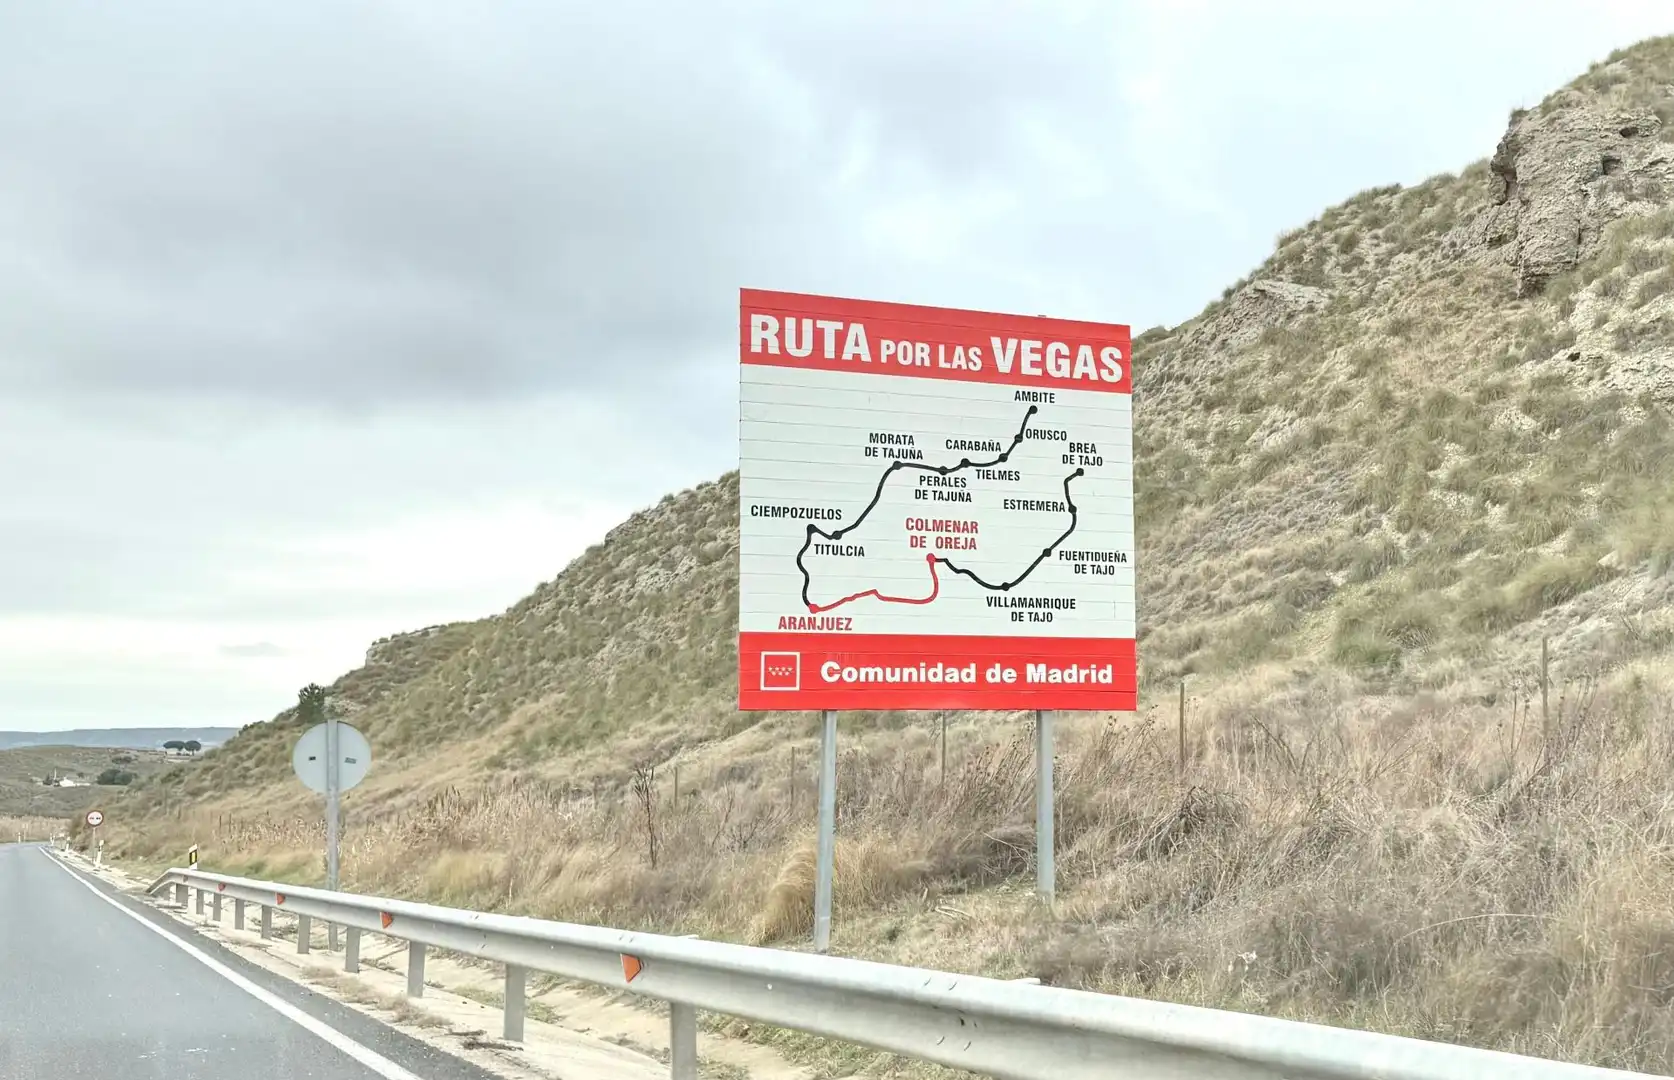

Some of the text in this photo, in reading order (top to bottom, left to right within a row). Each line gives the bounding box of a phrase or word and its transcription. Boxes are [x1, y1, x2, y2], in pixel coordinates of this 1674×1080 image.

[750, 314, 1123, 383] RUTA POR LAS VEGAS
[1014, 390, 1055, 404] AMBITE
[869, 433, 915, 446] MORATA
[1026, 429, 1067, 441] ORUSCO
[946, 438, 1002, 452] CARABAÑA
[1069, 442, 1097, 454] BREA
[865, 446, 923, 460] DE TAJUÑA
[1062, 454, 1103, 467] DE TAJO
[919, 475, 967, 488] PERALES
[976, 469, 1020, 482] TIELMES
[915, 489, 972, 503] DE TAJUÑA
[750, 505, 842, 521] CIEMPOZUELOS
[1003, 499, 1066, 513] ESTREMERA
[906, 517, 979, 534] COLMENAR
[910, 535, 977, 550] DE OREJA
[814, 544, 865, 557] TITULCIA
[1059, 550, 1127, 563] FUENTIDUEÑA
[1074, 563, 1115, 576] DE TAJO
[986, 596, 1076, 610] VILLAMANRIQUE
[778, 616, 853, 631] ARANJUEZ
[1011, 611, 1053, 623] DE TAJO
[820, 660, 1113, 684] Comunidad de Madrid
